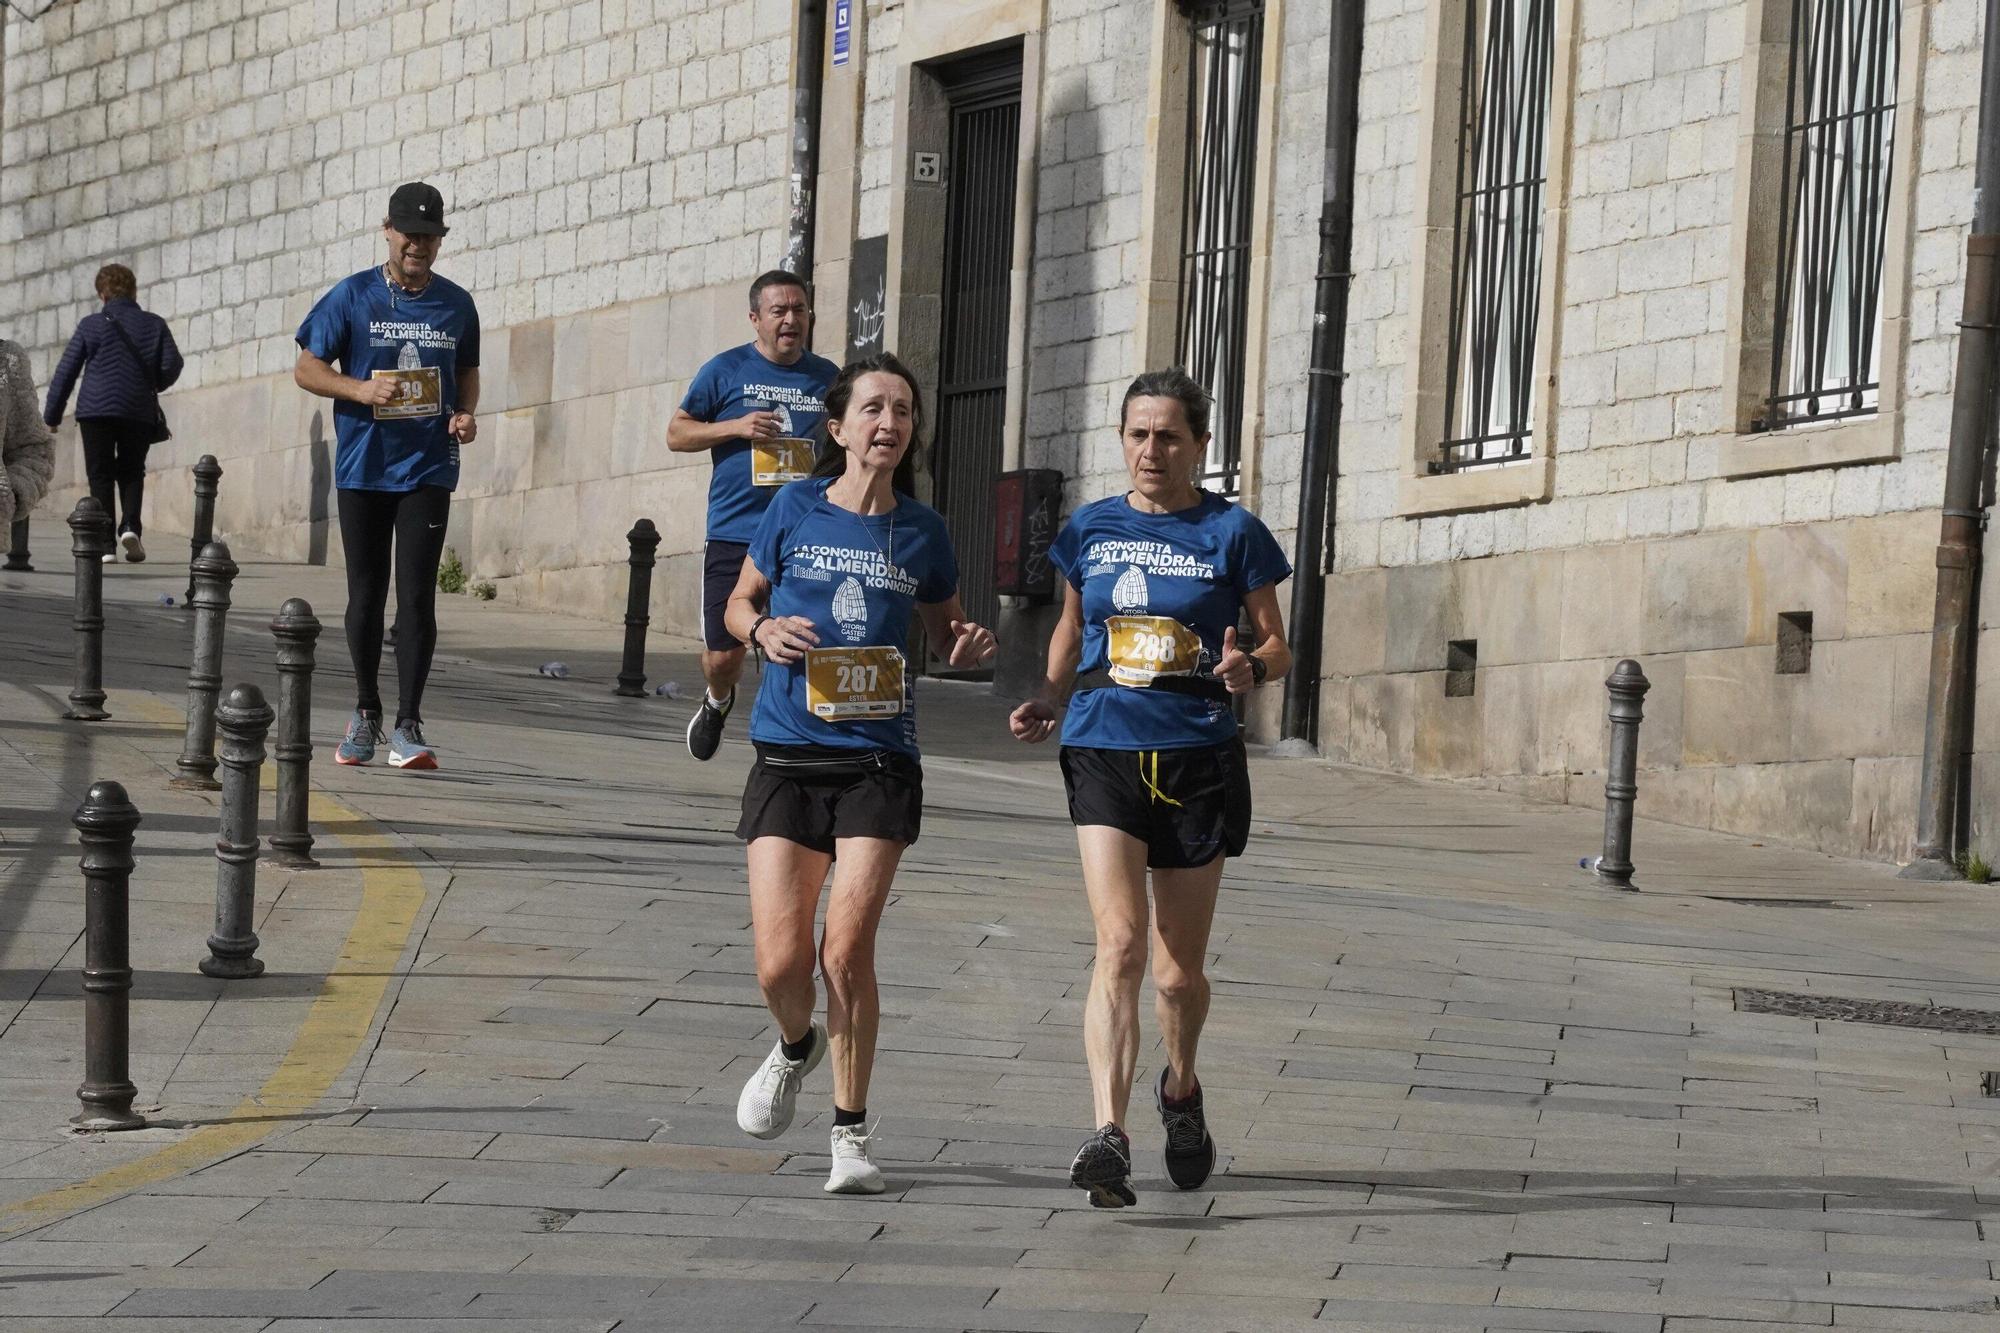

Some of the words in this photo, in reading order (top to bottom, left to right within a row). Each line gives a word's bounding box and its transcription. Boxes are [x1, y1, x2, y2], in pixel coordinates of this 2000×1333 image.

[920, 156, 934, 176] 5
[380, 322, 431, 330] CONQUISTA
[383, 330, 447, 341] ALMENDRA
[419, 340, 455, 349] KONKISTA
[395, 380, 422, 399] 39
[755, 384, 802, 395] CONQUISTA
[757, 391, 818, 405] ALMENDRA
[1090, 543, 1100, 554] LA
[1100, 541, 1171, 554] CONQUISTA
[811, 546, 885, 563] CONQUISTA
[1100, 550, 1196, 567] ALMENDRA
[812, 555, 907, 582] ALMENDRA
[1148, 566, 1213, 579] KONKISTA
[865, 576, 917, 596] KONKISTA
[841, 622, 866, 631] VITORIA
[841, 629, 866, 637] GASTEIZ
[1131, 632, 1176, 662] 288
[1144, 663, 1155, 671] EVA
[836, 665, 878, 692] 287
